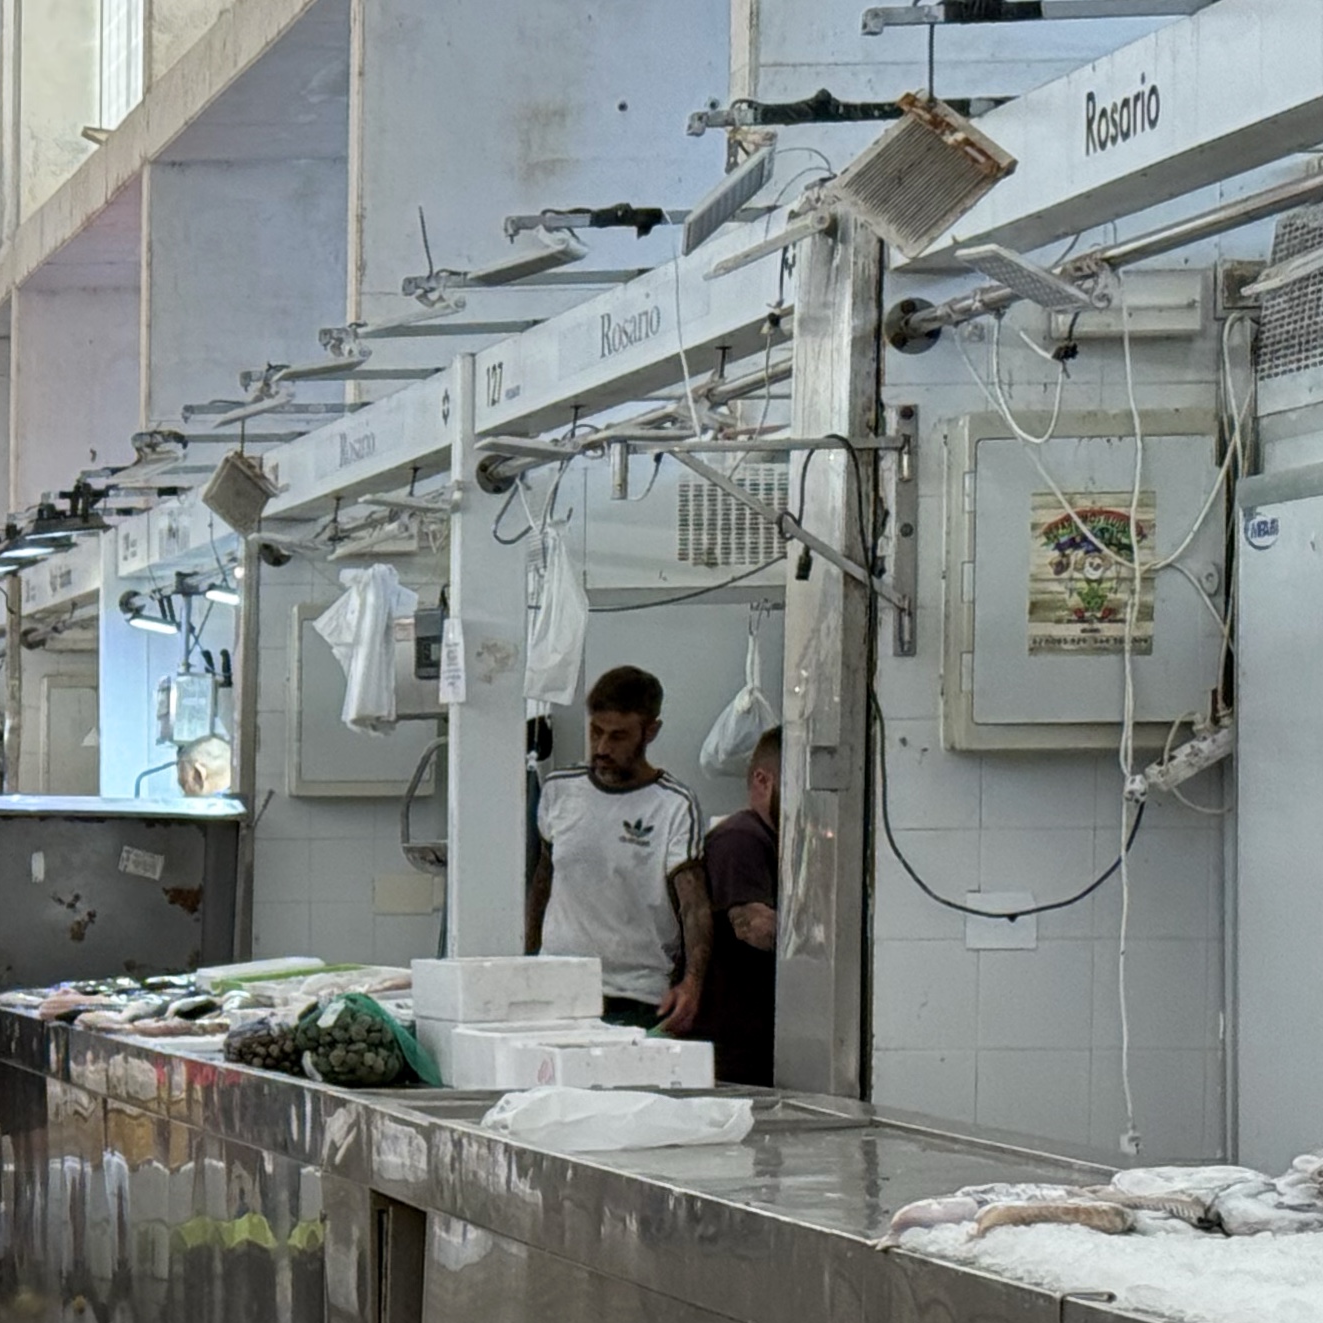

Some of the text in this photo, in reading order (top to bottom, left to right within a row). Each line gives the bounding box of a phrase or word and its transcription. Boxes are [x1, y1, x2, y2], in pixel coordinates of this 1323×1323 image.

[1085, 71, 1161, 157] Rosario
[600, 291, 662, 359] Rosario
[486, 361, 504, 407] 127
